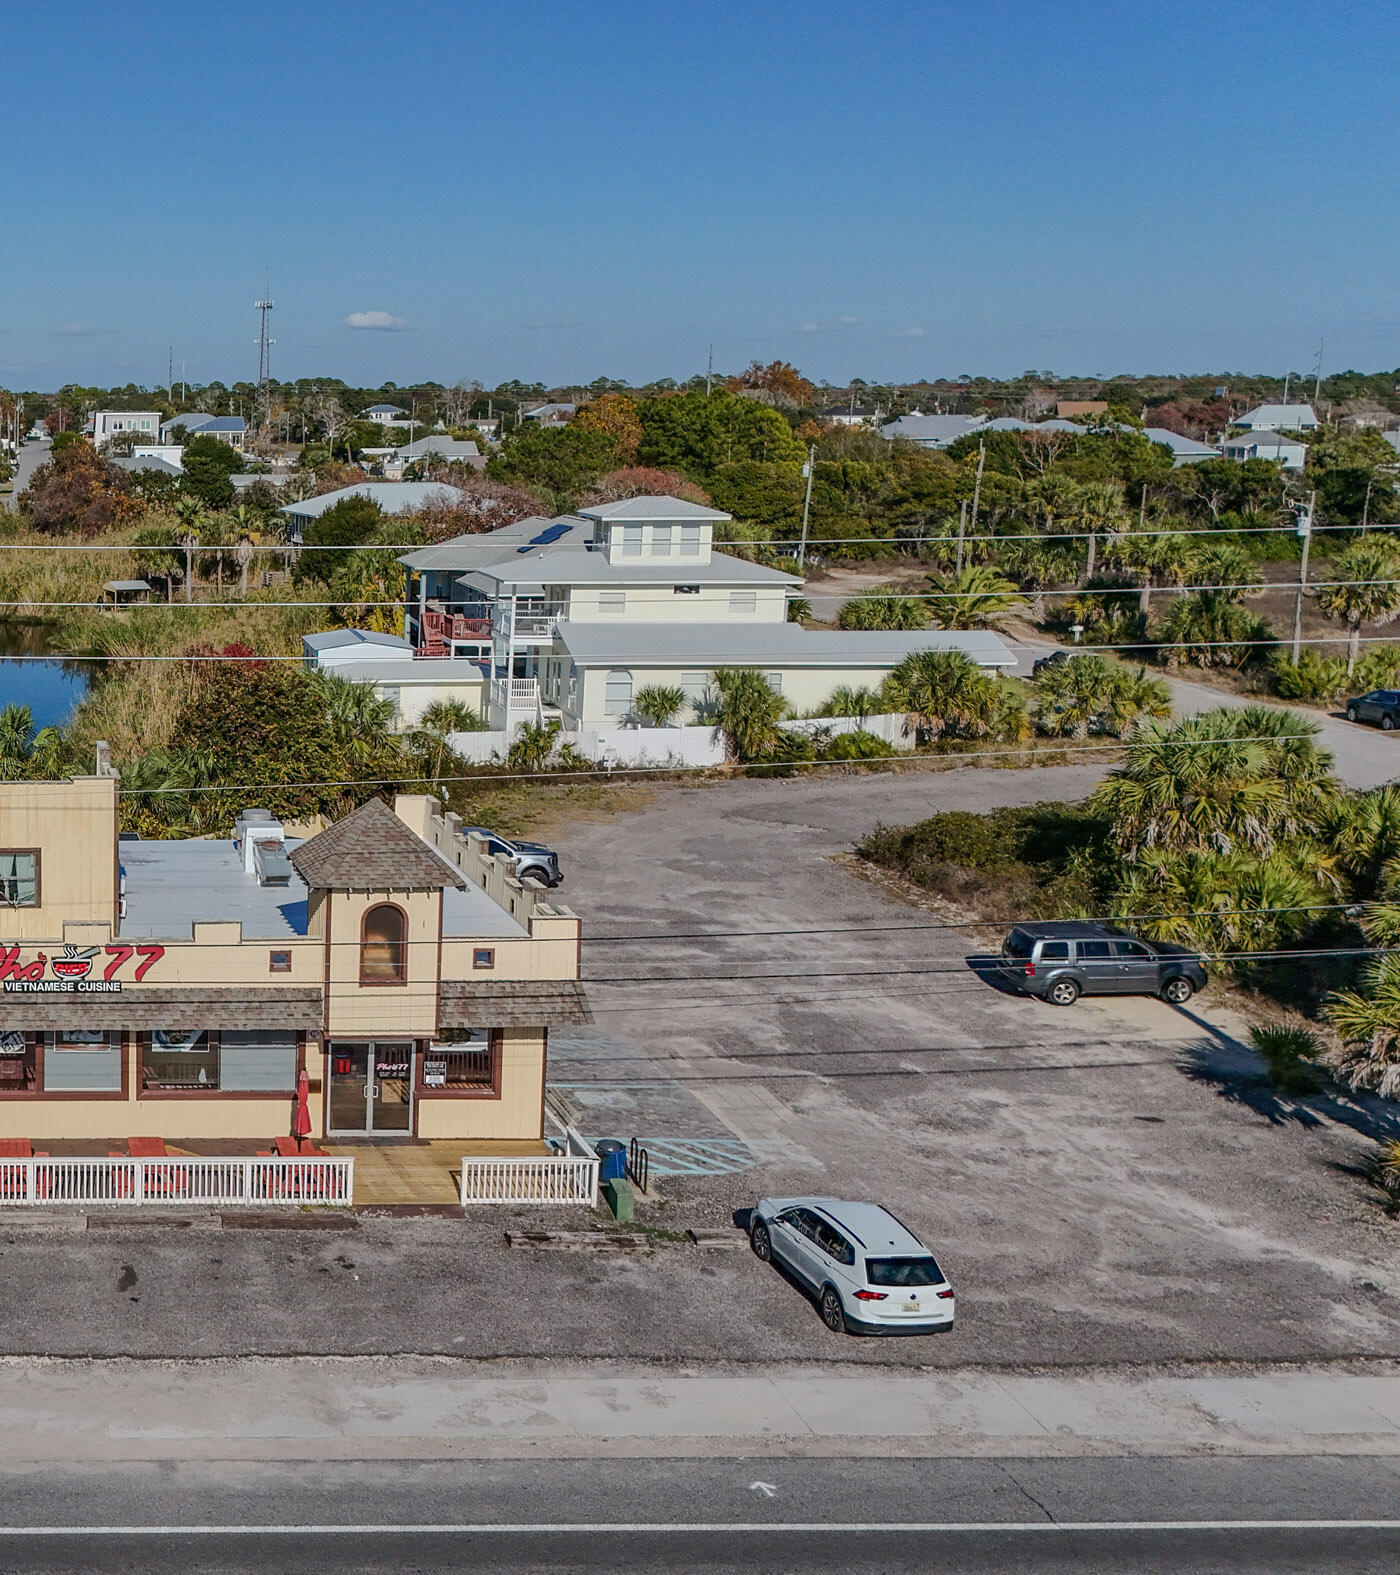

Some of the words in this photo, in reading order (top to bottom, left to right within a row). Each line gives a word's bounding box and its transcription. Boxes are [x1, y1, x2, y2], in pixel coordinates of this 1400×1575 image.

[103, 944, 165, 983] 77
[4, 982, 75, 992] VIETNAMESE
[77, 982, 121, 992] CUISINE
